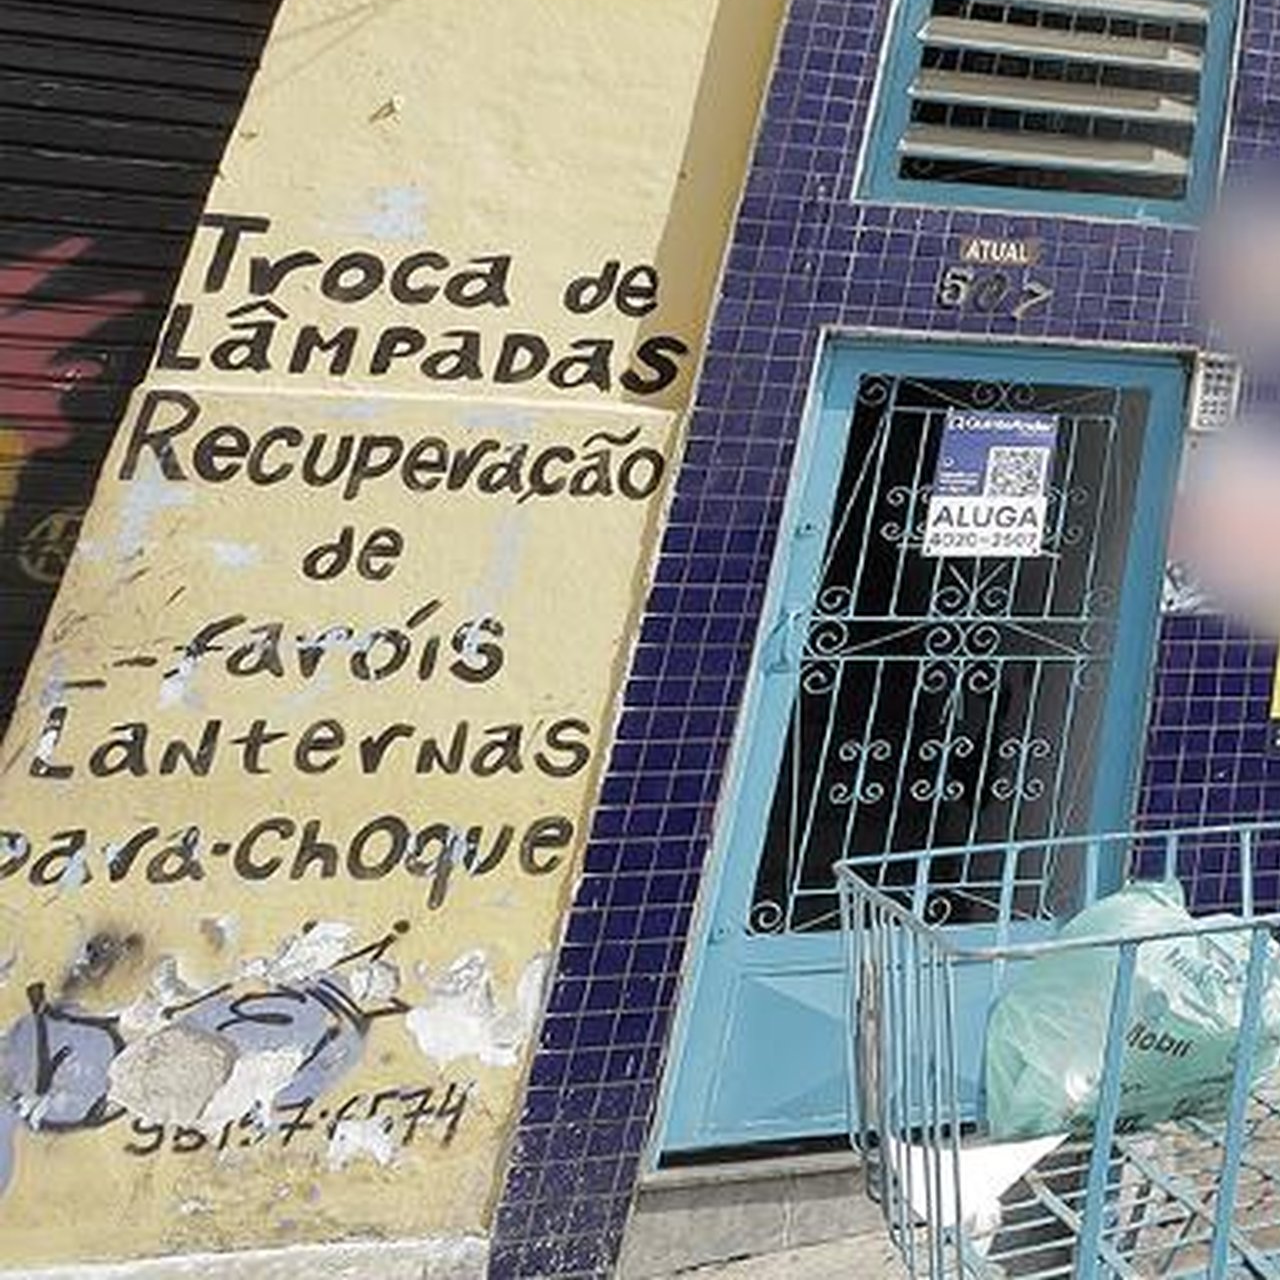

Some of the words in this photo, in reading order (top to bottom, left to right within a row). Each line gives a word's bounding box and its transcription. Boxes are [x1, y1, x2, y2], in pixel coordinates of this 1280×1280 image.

[202, 213, 513, 309] Troca
[564, 260, 660, 317] de
[964, 238, 1030, 263] ATUAL
[932, 505, 1039, 529] ALUGA
[301, 525, 405, 581] de
